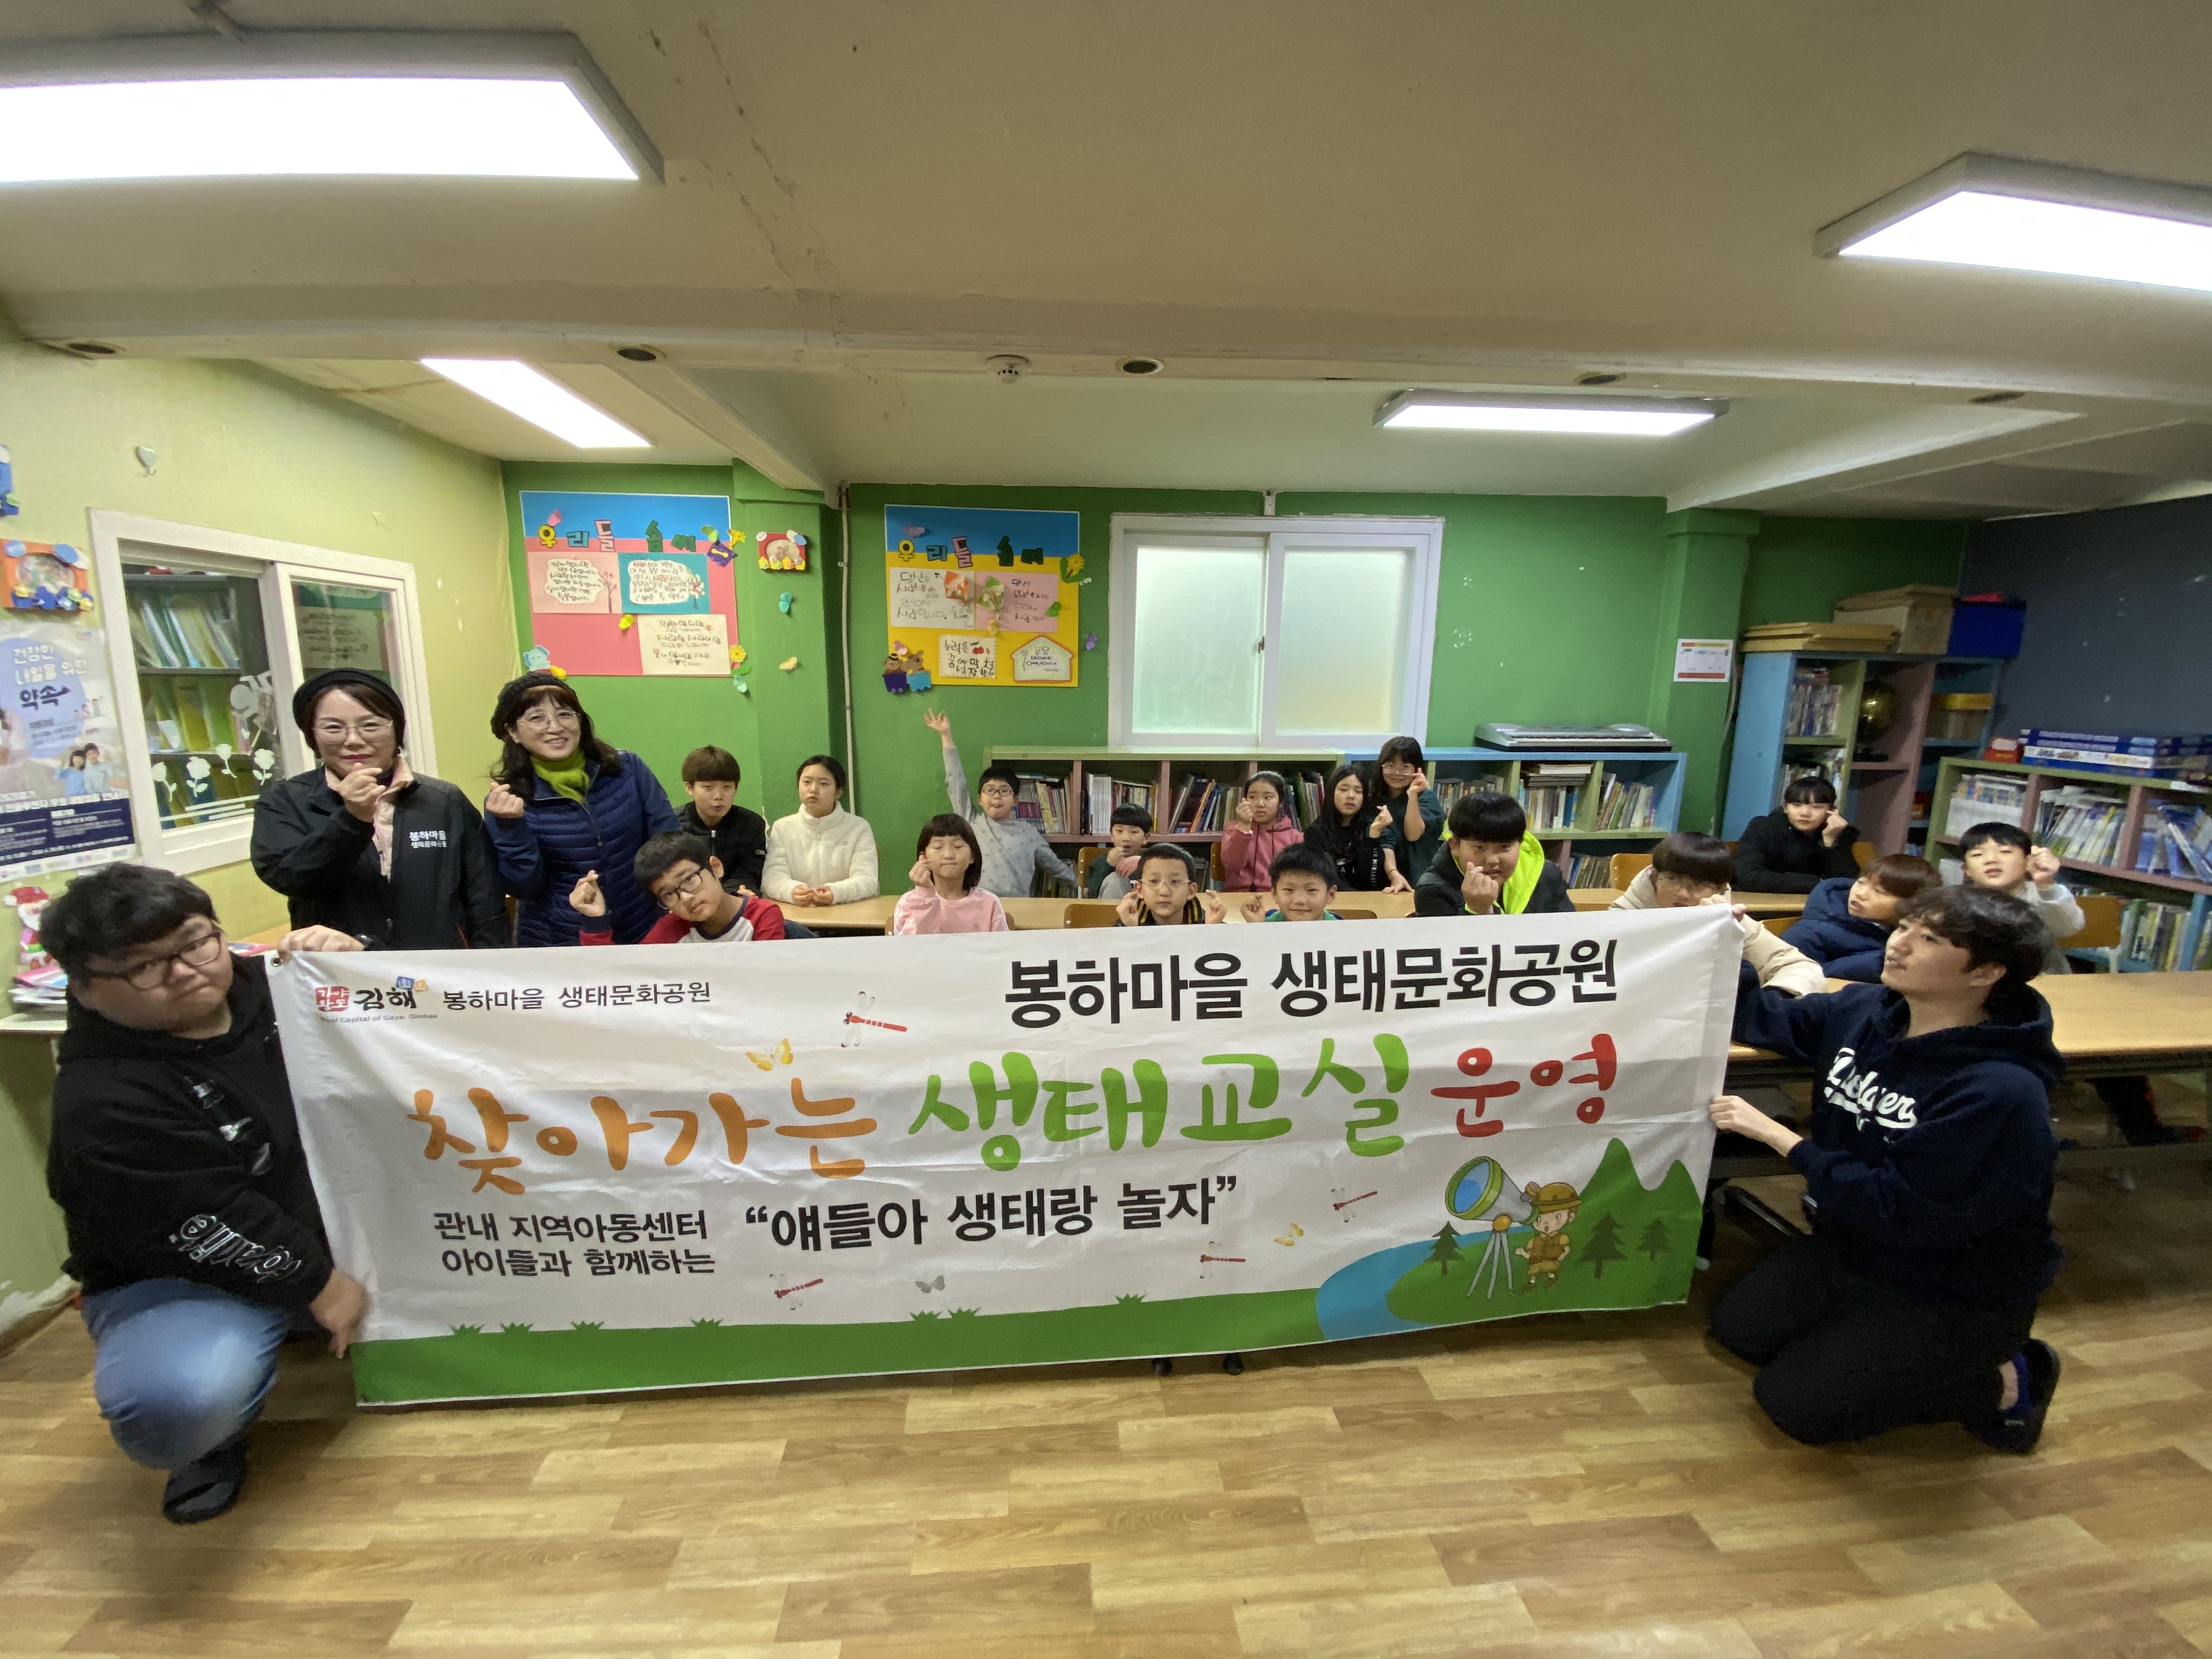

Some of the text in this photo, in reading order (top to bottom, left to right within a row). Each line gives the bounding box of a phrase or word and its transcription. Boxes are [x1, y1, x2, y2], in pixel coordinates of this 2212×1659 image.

[20, 686, 72, 710] 약속
[409, 830, 447, 842] 봉하마을
[353, 987, 417, 1011] 김해
[443, 981, 711, 1011] 봉하마을 생태문화공원
[1005, 939, 1617, 1029] 봉하마을 생태문화공원
[340, 1015, 370, 1024] Capital
[407, 1077, 877, 1195] 찾아가는
[1430, 1034, 1617, 1138] 운영
[432, 1209, 707, 1244] 관내 지역아동센터
[947, 1184, 1098, 1242] 생태랑
[441, 1248, 716, 1278] 아이들과 함께하는
